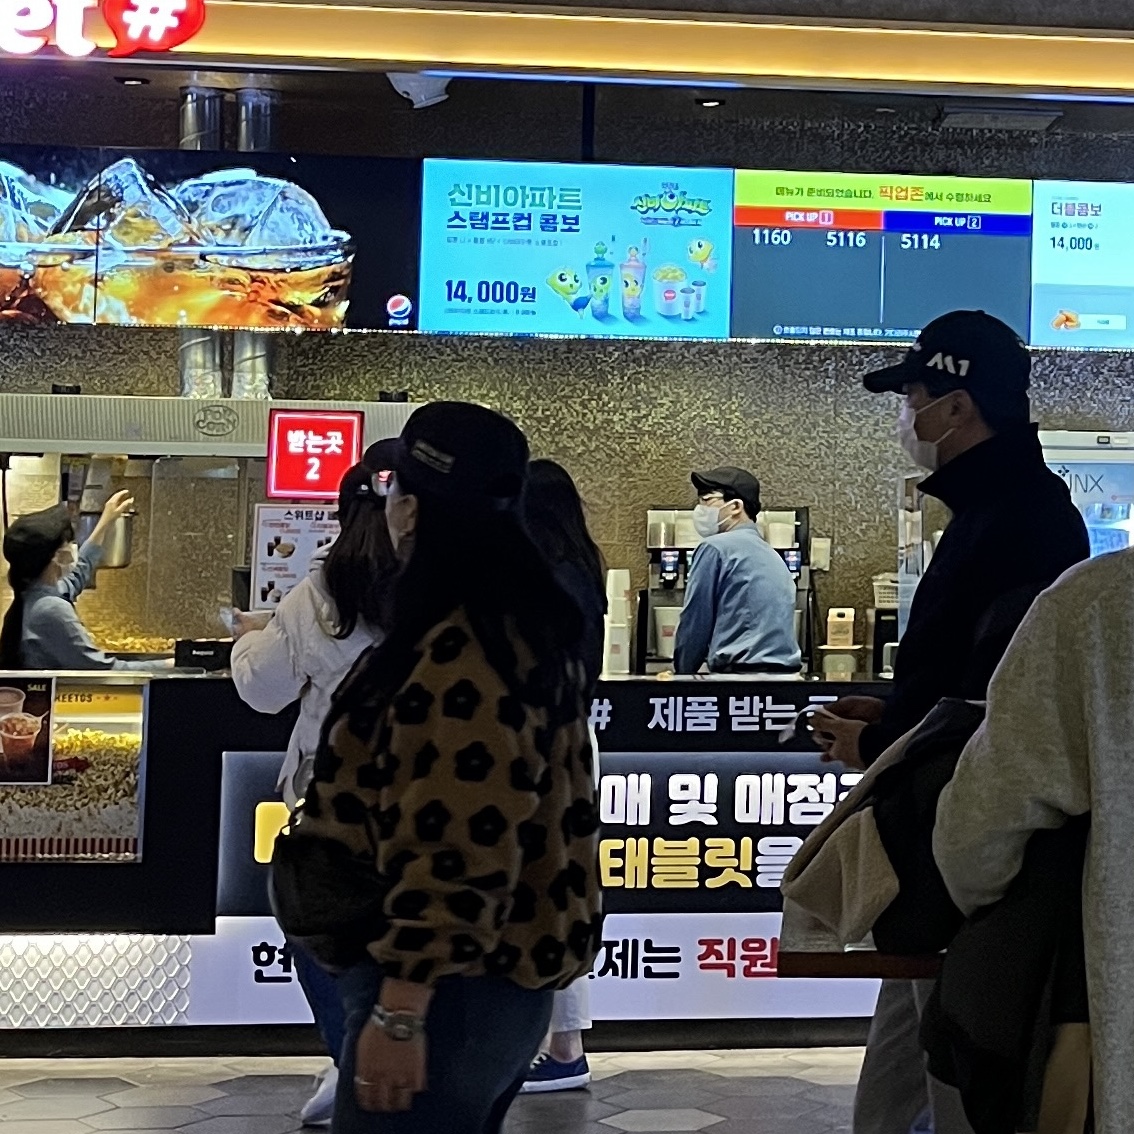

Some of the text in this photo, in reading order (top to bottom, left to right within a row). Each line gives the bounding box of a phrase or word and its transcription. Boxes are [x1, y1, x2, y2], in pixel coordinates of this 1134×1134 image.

[447, 183, 583, 210] 신비아파트
[879, 185, 944, 202] 픽업존에서
[446, 211, 581, 233] 스탬프컵 콤보
[934, 216, 953, 226] PICK
[954, 217, 966, 226] UP
[752, 228, 792, 245] 1160
[826, 231, 866, 247] 5116
[900, 233, 941, 250] 5114
[445, 279, 537, 304] 14,000원
[286, 430, 345, 455] 받는곳
[304, 457, 321, 481] 2
[647, 696, 720, 732] 제품
[728, 696, 799, 732] 받는
[668, 772, 719, 826] 및
[599, 836, 804, 889] 태블릿을
